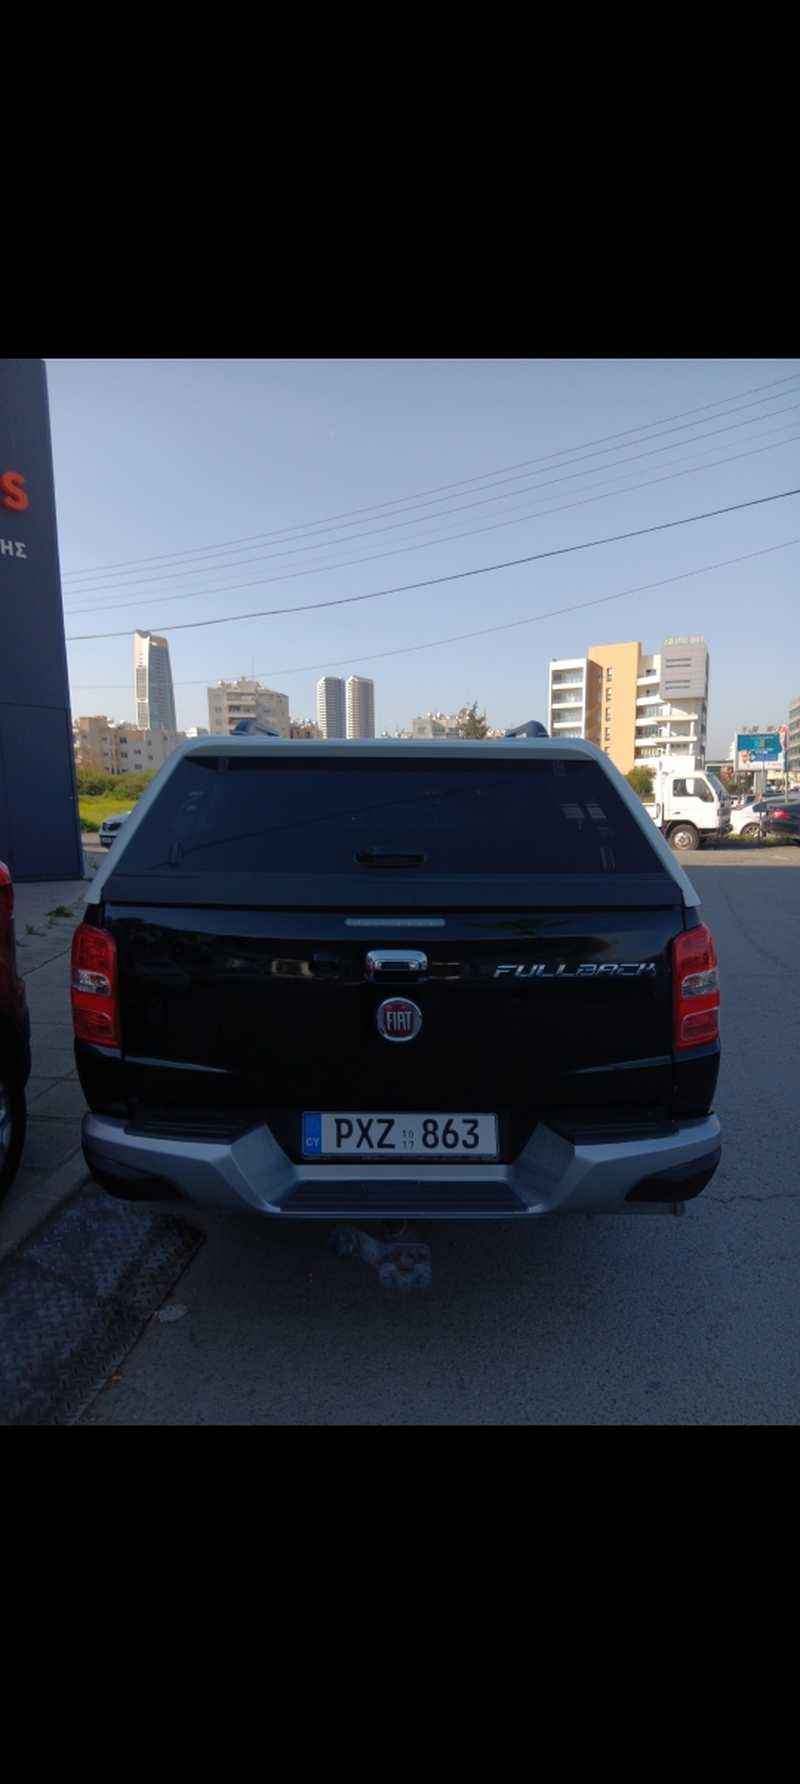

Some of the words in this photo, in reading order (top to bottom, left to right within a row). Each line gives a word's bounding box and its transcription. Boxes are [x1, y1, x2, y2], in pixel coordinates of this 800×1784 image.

[0, 471, 31, 511] S
[493, 962, 657, 978] FULLBACK
[386, 1011, 412, 1031] FIAT
[305, 1137, 320, 1147] CY
[335, 1118, 396, 1149] PXZ
[422, 1119, 480, 1149] 863
